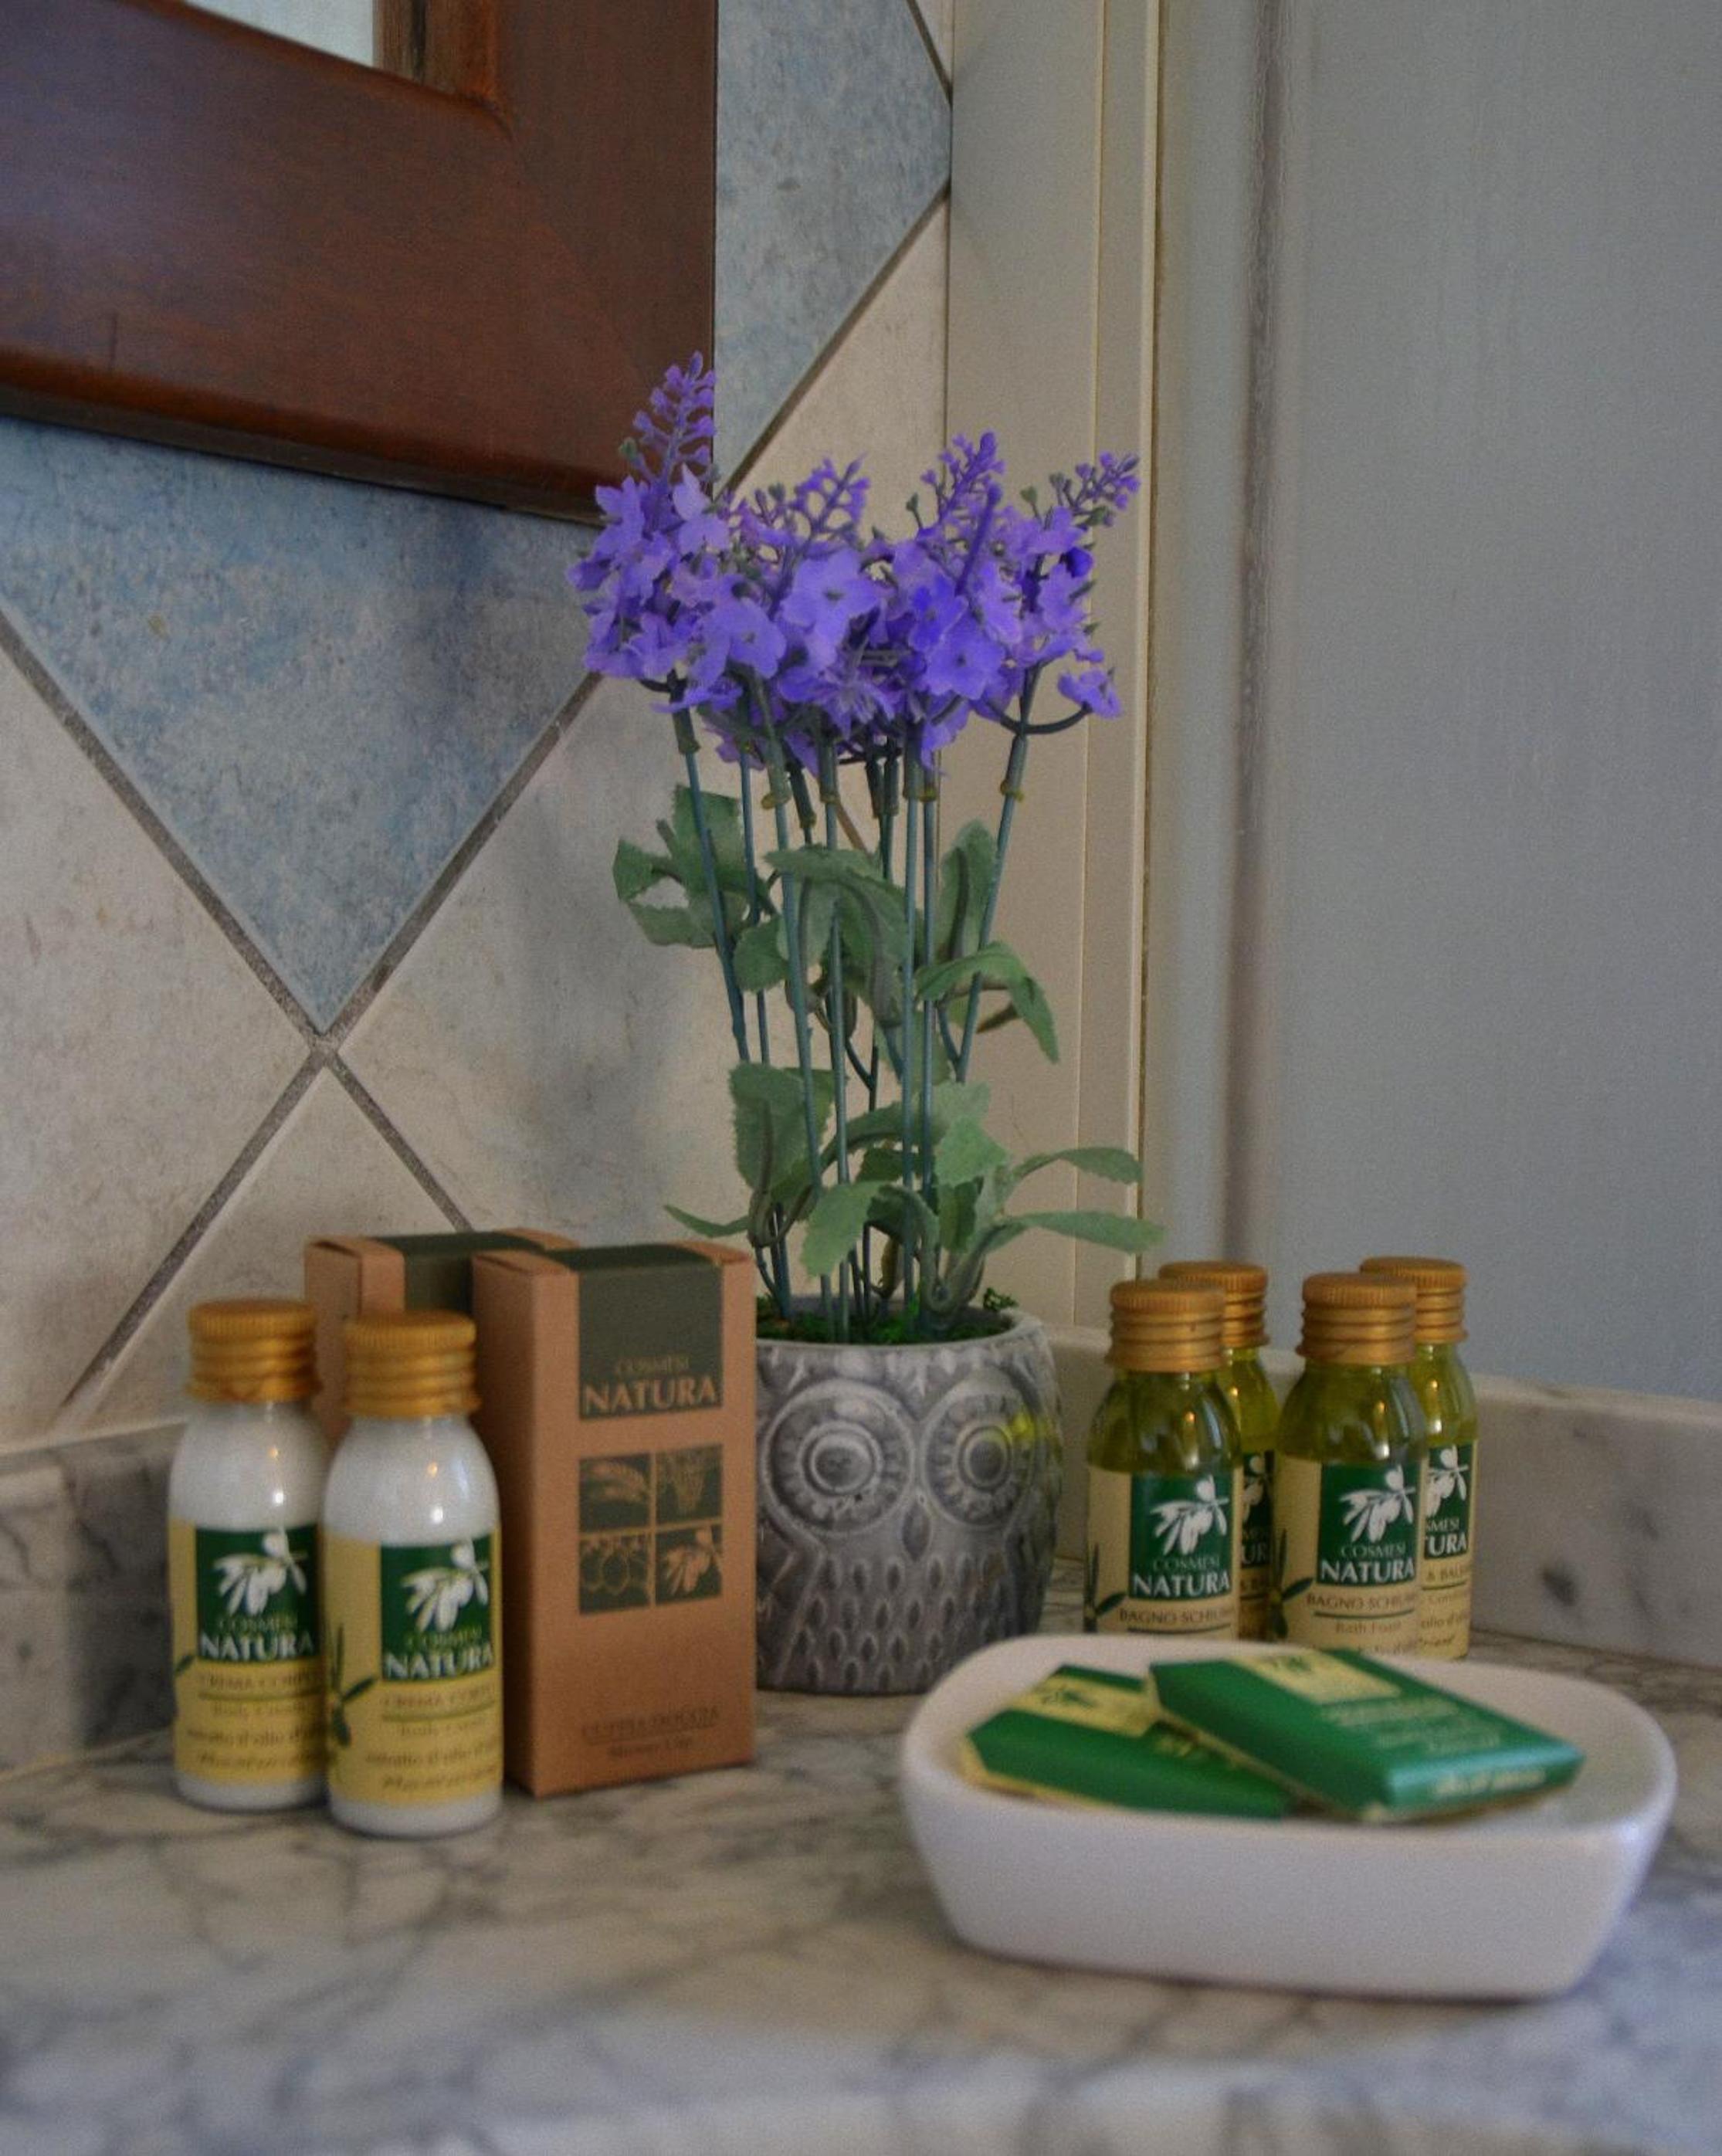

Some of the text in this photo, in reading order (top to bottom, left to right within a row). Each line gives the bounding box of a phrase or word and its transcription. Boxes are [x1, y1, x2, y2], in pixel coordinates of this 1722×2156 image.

[582, 1375, 716, 1415] NATURA
[1341, 1542, 1406, 1558] COSMESI
[1153, 1555, 1221, 1571] COSMESI
[1320, 1558, 1415, 1582] NATURA
[1133, 1570, 1231, 1597] NATURA
[1307, 1594, 1364, 1609] BAGNO
[1120, 1608, 1176, 1623] BAGNO
[201, 1632, 314, 1660] NATURA
[384, 1642, 493, 1680] NATURA
